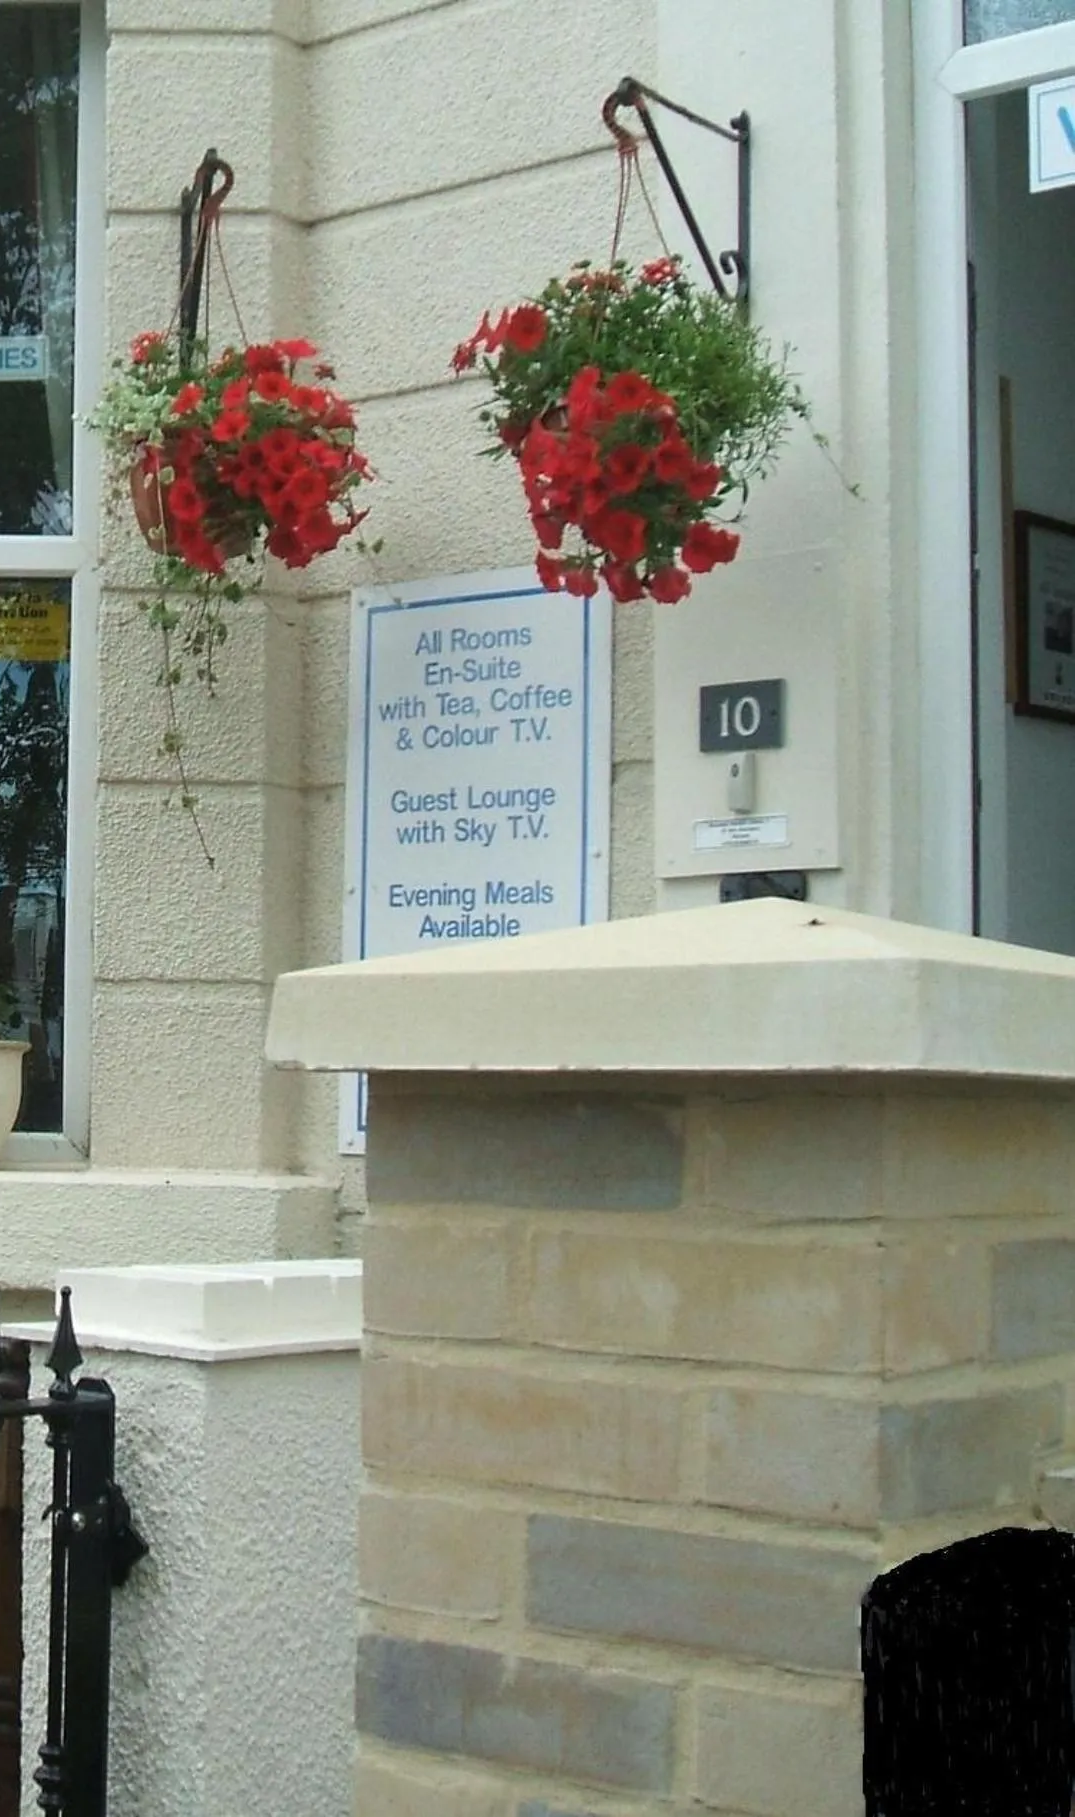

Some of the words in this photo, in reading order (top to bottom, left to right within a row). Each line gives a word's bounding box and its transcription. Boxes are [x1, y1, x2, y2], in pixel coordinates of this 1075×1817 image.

[415, 631, 442, 656] All
[450, 626, 531, 652] Rooms
[424, 657, 520, 686] En-Suite
[379, 696, 425, 721] with
[436, 692, 480, 717] Tea,
[490, 684, 572, 712] Coffee
[719, 696, 761, 737] 10
[395, 727, 413, 751] &
[422, 724, 499, 749] Colour
[510, 716, 551, 742] T.V.
[391, 788, 458, 813] Guest
[468, 786, 555, 813] Lounge
[397, 820, 444, 844] with
[455, 818, 496, 847] Sky
[507, 815, 548, 839] T.V.
[389, 883, 475, 912] Evening
[485, 880, 553, 904] Meals
[419, 914, 520, 938] Available
